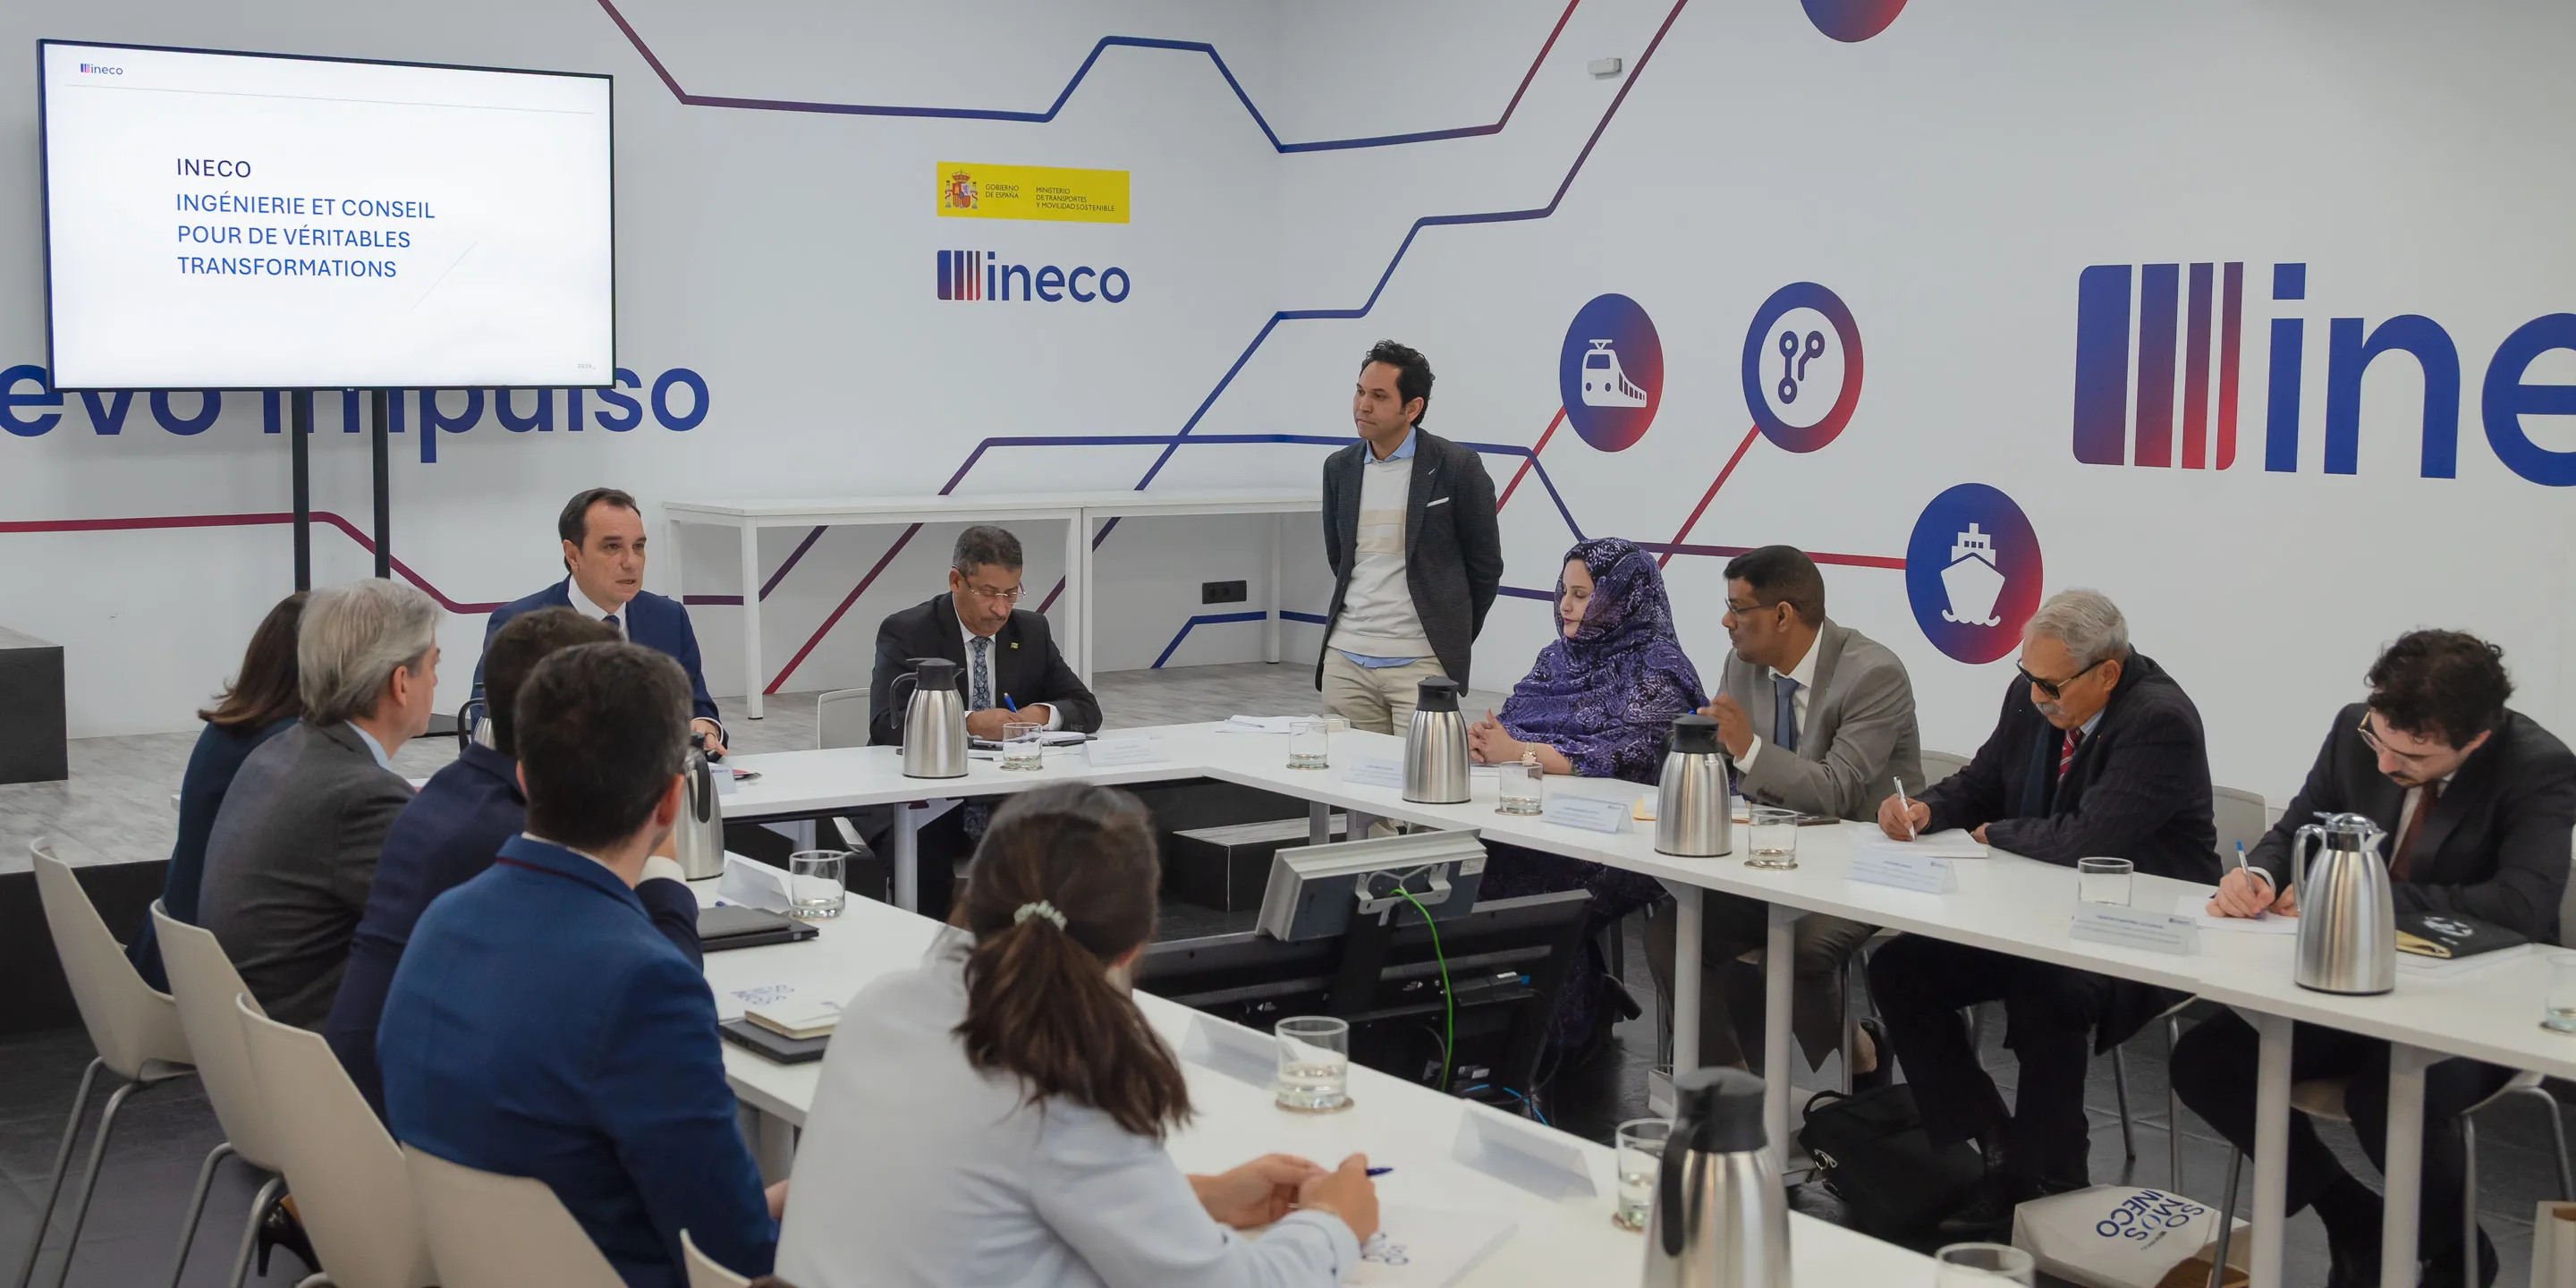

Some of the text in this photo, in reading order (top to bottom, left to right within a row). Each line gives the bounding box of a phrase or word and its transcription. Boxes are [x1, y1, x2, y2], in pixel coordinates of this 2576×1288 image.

[91, 64, 123, 75] ineco
[177, 157, 251, 178] INECO
[996, 191, 1020, 199] ESPAÑA
[1036, 186, 1071, 195] MINISTERIO
[1046, 195, 1087, 203] TRANSPORTES
[176, 191, 436, 219] INGÉNIERIE ET CONSEIL
[178, 224, 411, 249] POUR DE VÉRITABLES
[177, 256, 397, 278] TRANSFORMATIONS
[987, 250, 1131, 303] ineco
[2264, 262, 2576, 487] ine
[0, 364, 222, 437] evo
[2096, 1190, 2165, 1238] INECO
[2165, 1204, 2205, 1228] SO
